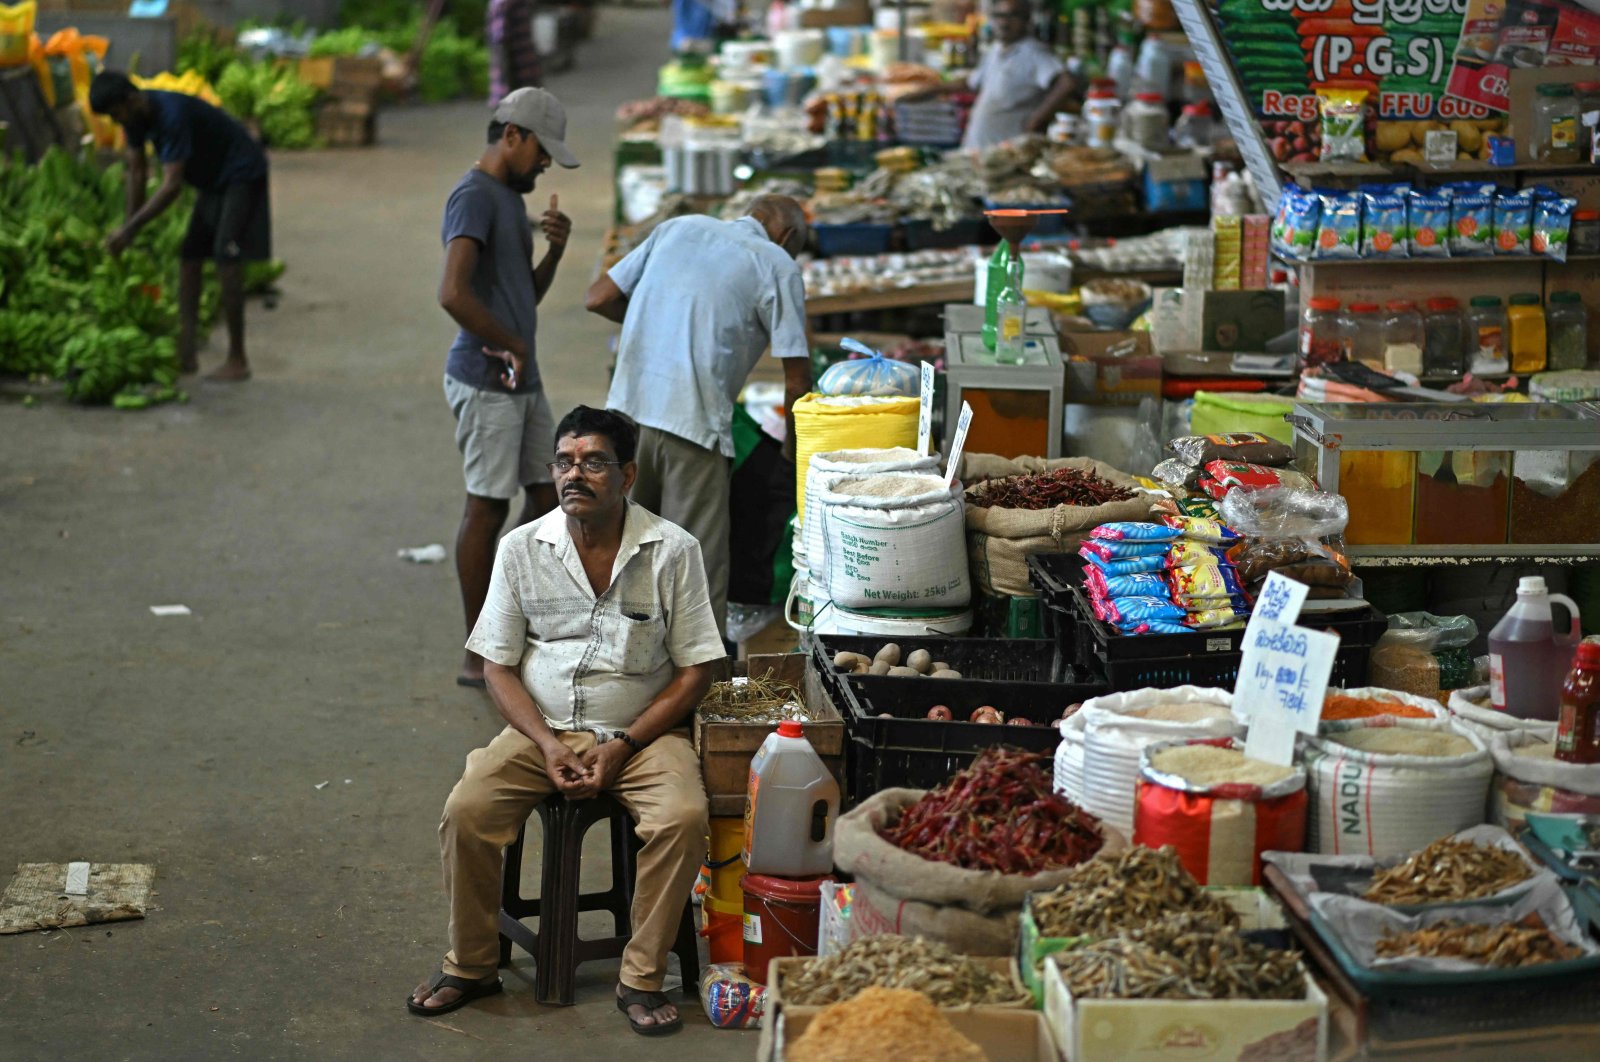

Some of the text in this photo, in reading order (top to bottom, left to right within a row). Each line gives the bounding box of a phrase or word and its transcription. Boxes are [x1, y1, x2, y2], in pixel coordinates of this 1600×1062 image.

[1312, 35, 1444, 84] (P.G.S)
[1479, 74, 1510, 98] CB
[1380, 93, 1432, 117] FFU
[858, 537, 888, 547] Number
[842, 547, 880, 562] Best Before
[864, 585, 947, 601] Net Weight: 25kg
[1341, 764, 1362, 835] NADU
